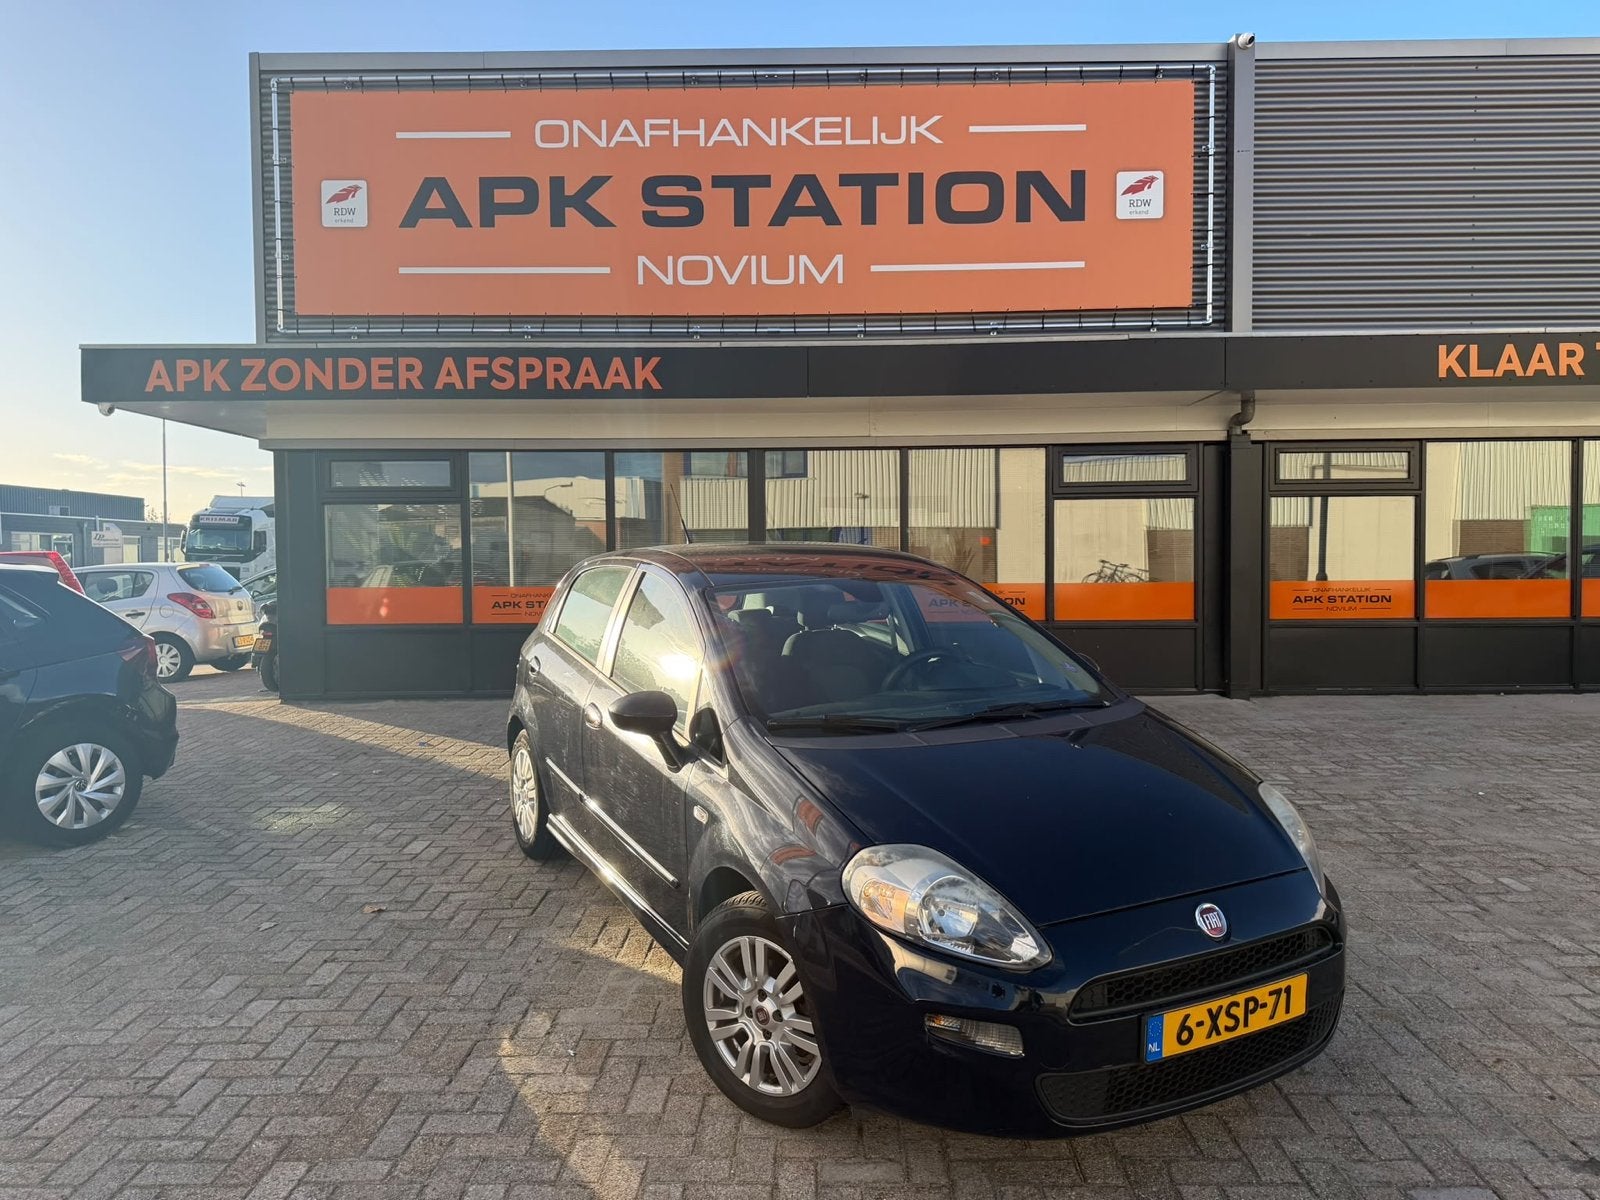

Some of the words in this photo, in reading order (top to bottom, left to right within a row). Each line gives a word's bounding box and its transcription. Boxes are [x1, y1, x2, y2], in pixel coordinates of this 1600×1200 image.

[534, 114, 943, 149] ONAFHANKELIJK
[398, 175, 617, 228] APK
[641, 170, 1086, 228] STATION
[1128, 198, 1152, 208] RDW
[333, 207, 356, 216] RDW
[637, 253, 844, 286] NOVIUM
[1438, 342, 1585, 378] KLAAR
[144, 358, 231, 393] APK
[240, 357, 425, 392] ZONDER
[434, 356, 663, 391] AFSPRAAK
[491, 601, 521, 609] APK
[929, 599, 958, 608] APK
[1293, 595, 1324, 604] APK
[1327, 595, 1392, 603] STATION
[1203, 911, 1221, 930] FIAT
[1176, 984, 1292, 1046] 6-XSP-71
[1148, 1041, 1160, 1053] NL
